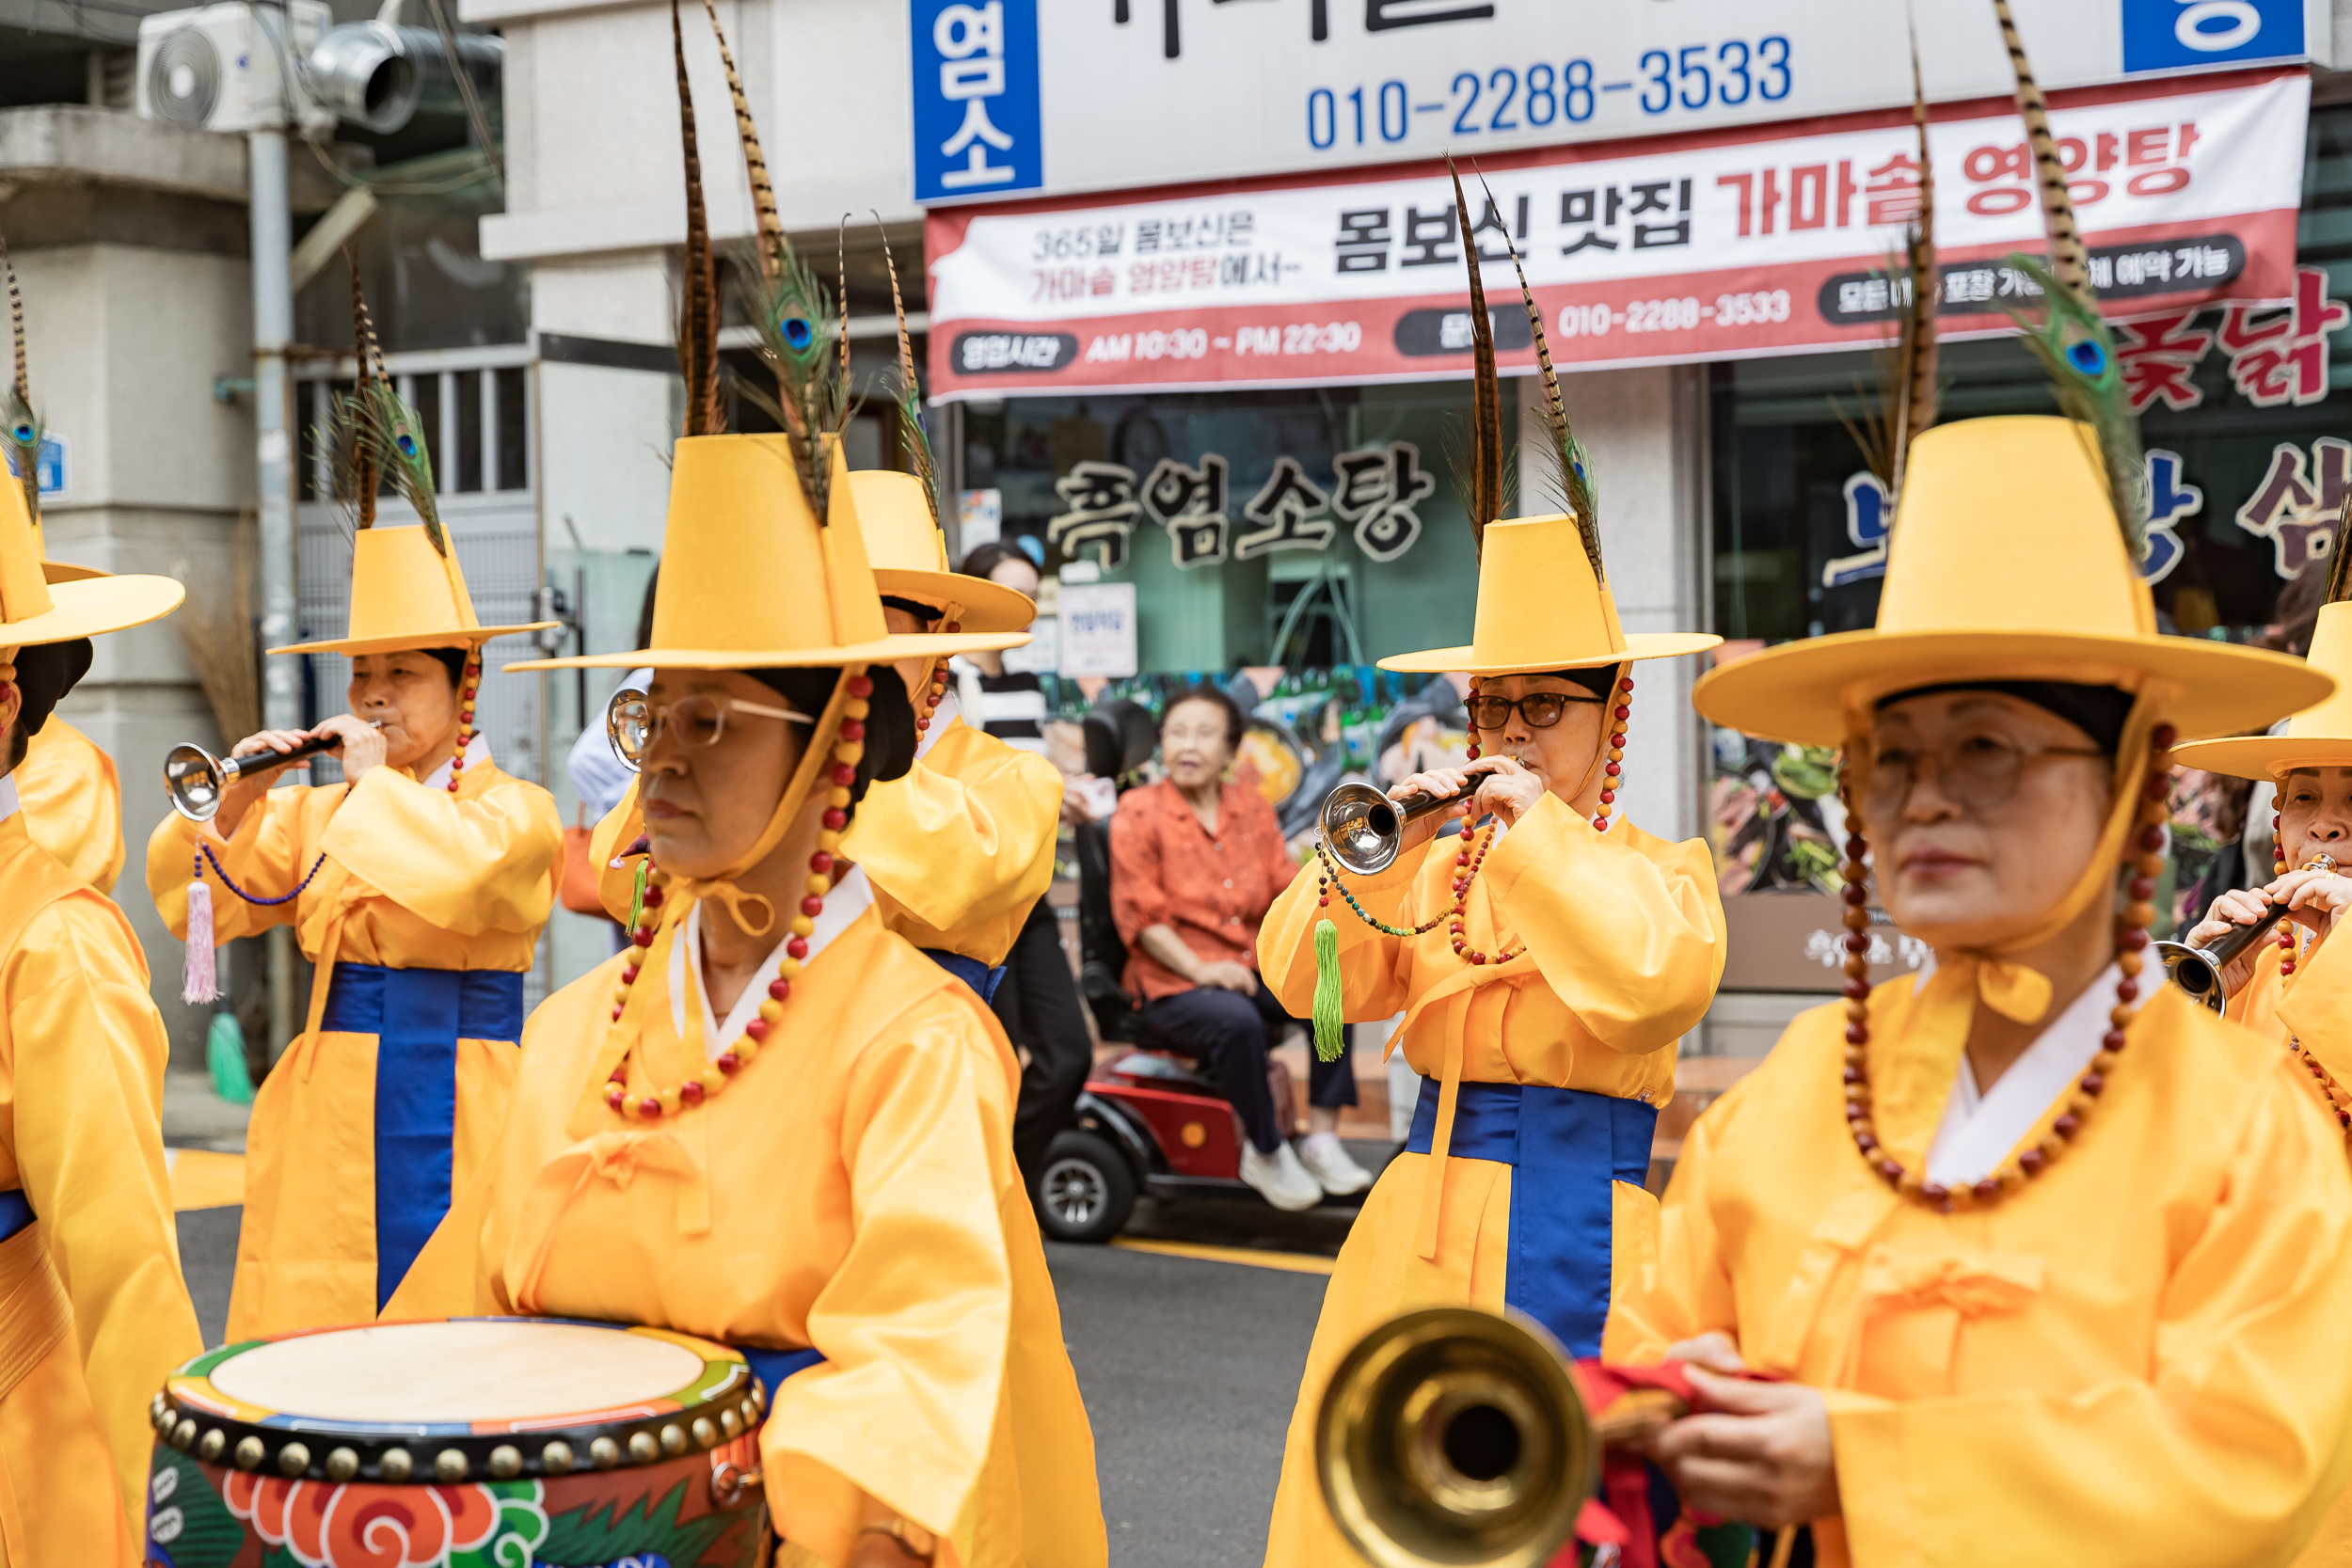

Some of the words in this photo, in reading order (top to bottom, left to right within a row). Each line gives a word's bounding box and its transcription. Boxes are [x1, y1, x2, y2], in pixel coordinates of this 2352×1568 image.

[932, 0, 1017, 188] 염소
[1307, 35, 1793, 151] 010-2288-3533
[1335, 195, 1529, 274] 몸보신
[1559, 178, 1692, 256] 맛집
[1715, 153, 1933, 237] 가마솥
[1963, 121, 2201, 216] 영양탕
[1032, 223, 1125, 261] 365일
[1135, 210, 1256, 254] 몸보신은
[1031, 263, 1119, 303] 가마솥
[2116, 250, 2174, 286] 예약
[2174, 245, 2232, 279] 가능
[1558, 288, 1791, 339] 010-2288-3533
[961, 334, 1062, 371] 영업시간
[1085, 332, 1132, 364] AM
[1135, 327, 1209, 361] 10:30
[1235, 325, 1280, 357] PM
[1282, 321, 1362, 357] 22:30
[1046, 439, 1437, 572] 흑염소탕
